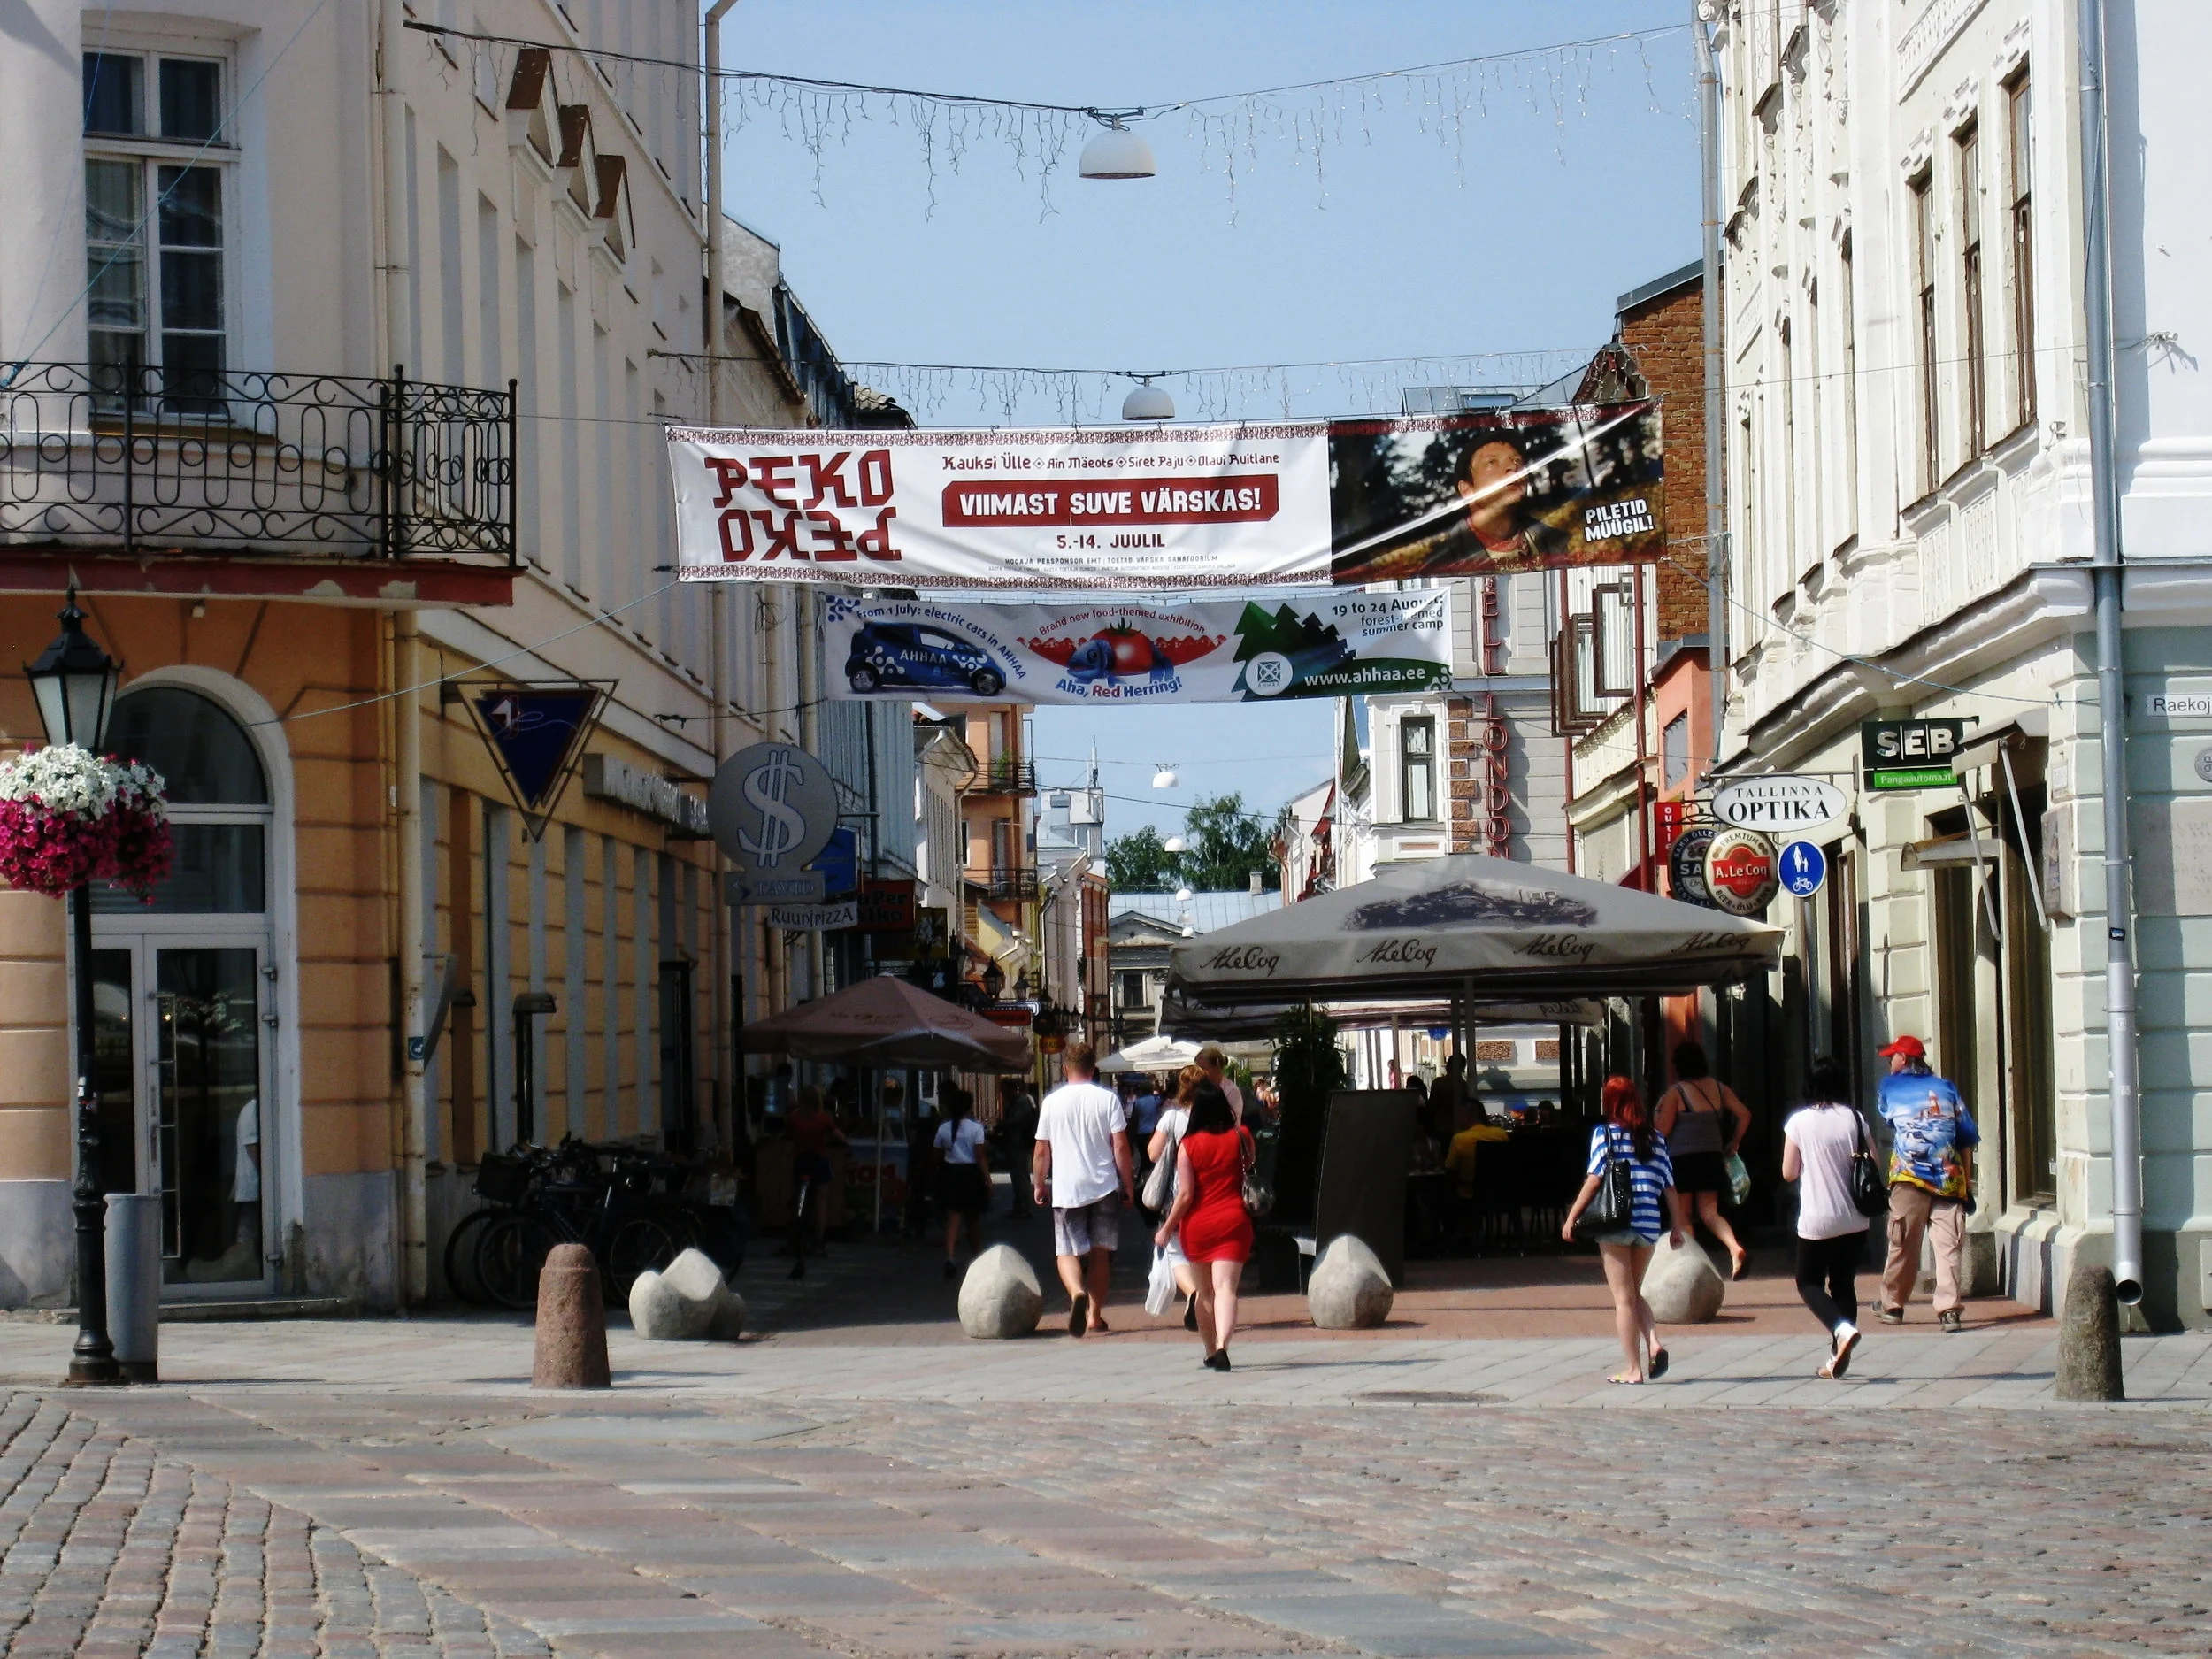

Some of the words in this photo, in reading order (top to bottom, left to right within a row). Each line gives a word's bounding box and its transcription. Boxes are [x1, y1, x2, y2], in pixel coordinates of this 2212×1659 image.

[942, 456, 997, 470] Kauksi
[1001, 452, 1031, 469] Ülle
[1047, 457, 1065, 469] Ain
[1068, 456, 1114, 469] Mäeots
[1128, 457, 1155, 468] Siret
[1157, 456, 1184, 470] Paju
[1198, 455, 1226, 466] Olavi
[703, 449, 894, 511] PEKO
[959, 492, 1058, 517] VIIMAST
[1070, 490, 1132, 516] SUVE
[1139, 486, 1262, 514] VÄRSKAS!
[1585, 498, 1648, 525] PILETID
[1584, 513, 1655, 542] MÜÜGIL!
[1056, 534, 1101, 549] 5.-14.
[1110, 533, 1165, 548] JUULIL
[1332, 605, 1348, 618] 19
[1352, 602, 1366, 614] to
[1371, 602, 1387, 614] 24
[1039, 616, 1068, 635] Brand
[1069, 611, 1090, 624] new
[1092, 607, 1156, 619] food-themed
[1158, 612, 1206, 634] exhibition
[1362, 622, 1409, 637] summer
[1412, 619, 1444, 631] camp
[856, 607, 885, 619] From
[895, 603, 921, 617] July:
[924, 606, 965, 626] electric
[965, 622, 988, 640] cars
[987, 634, 998, 647] in
[997, 645, 1026, 680] AHHAA
[900, 649, 947, 664] AHHAA
[1055, 679, 1089, 697] Aha,
[1092, 685, 1120, 698] Red
[1123, 676, 1183, 697] Herring!
[1304, 666, 1426, 687] www.ahhaa.ee
[1876, 728, 1955, 757] SEB
[1879, 773, 1953, 786] Pangaautomaat
[1734, 785, 1824, 798] TALLINNA
[1728, 799, 1831, 823] OPTIKA
[1720, 833, 1759, 847] PREMIUM
